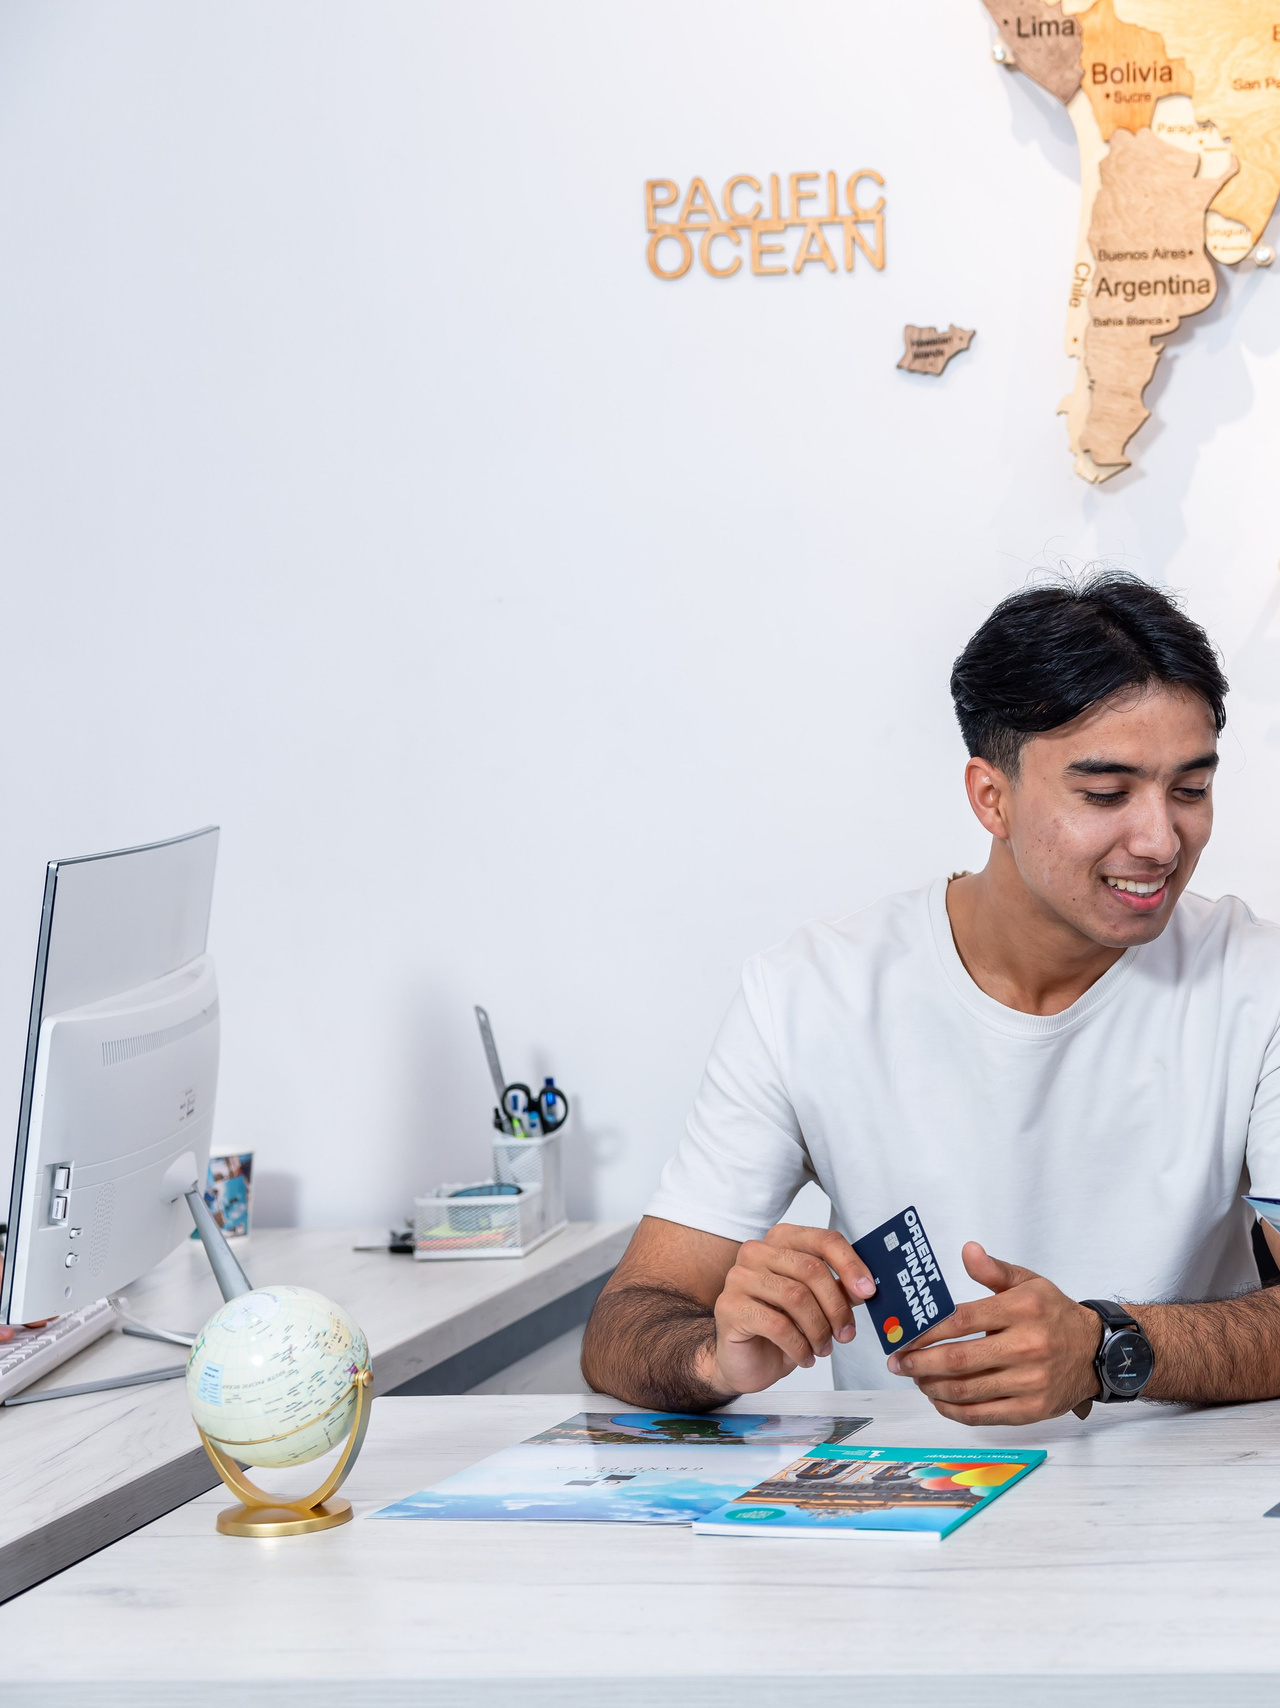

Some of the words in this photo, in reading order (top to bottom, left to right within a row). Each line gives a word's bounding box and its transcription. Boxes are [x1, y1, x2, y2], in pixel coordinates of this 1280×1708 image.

[1016, 16, 1075, 38] Lima
[1092, 62, 1173, 85] Bolivia
[1233, 78, 1261, 91] San
[644, 170, 886, 233] PACIFIC
[646, 217, 886, 280] OCEAN
[1099, 249, 1149, 261] Buenos
[1152, 247, 1187, 260] Aires
[1069, 262, 1091, 308] Chile
[1096, 275, 1210, 302] Argentina
[904, 1210, 941, 1282] ORIENT
[897, 1269, 929, 1331] BANK
[901, 1241, 938, 1319] FINANS
